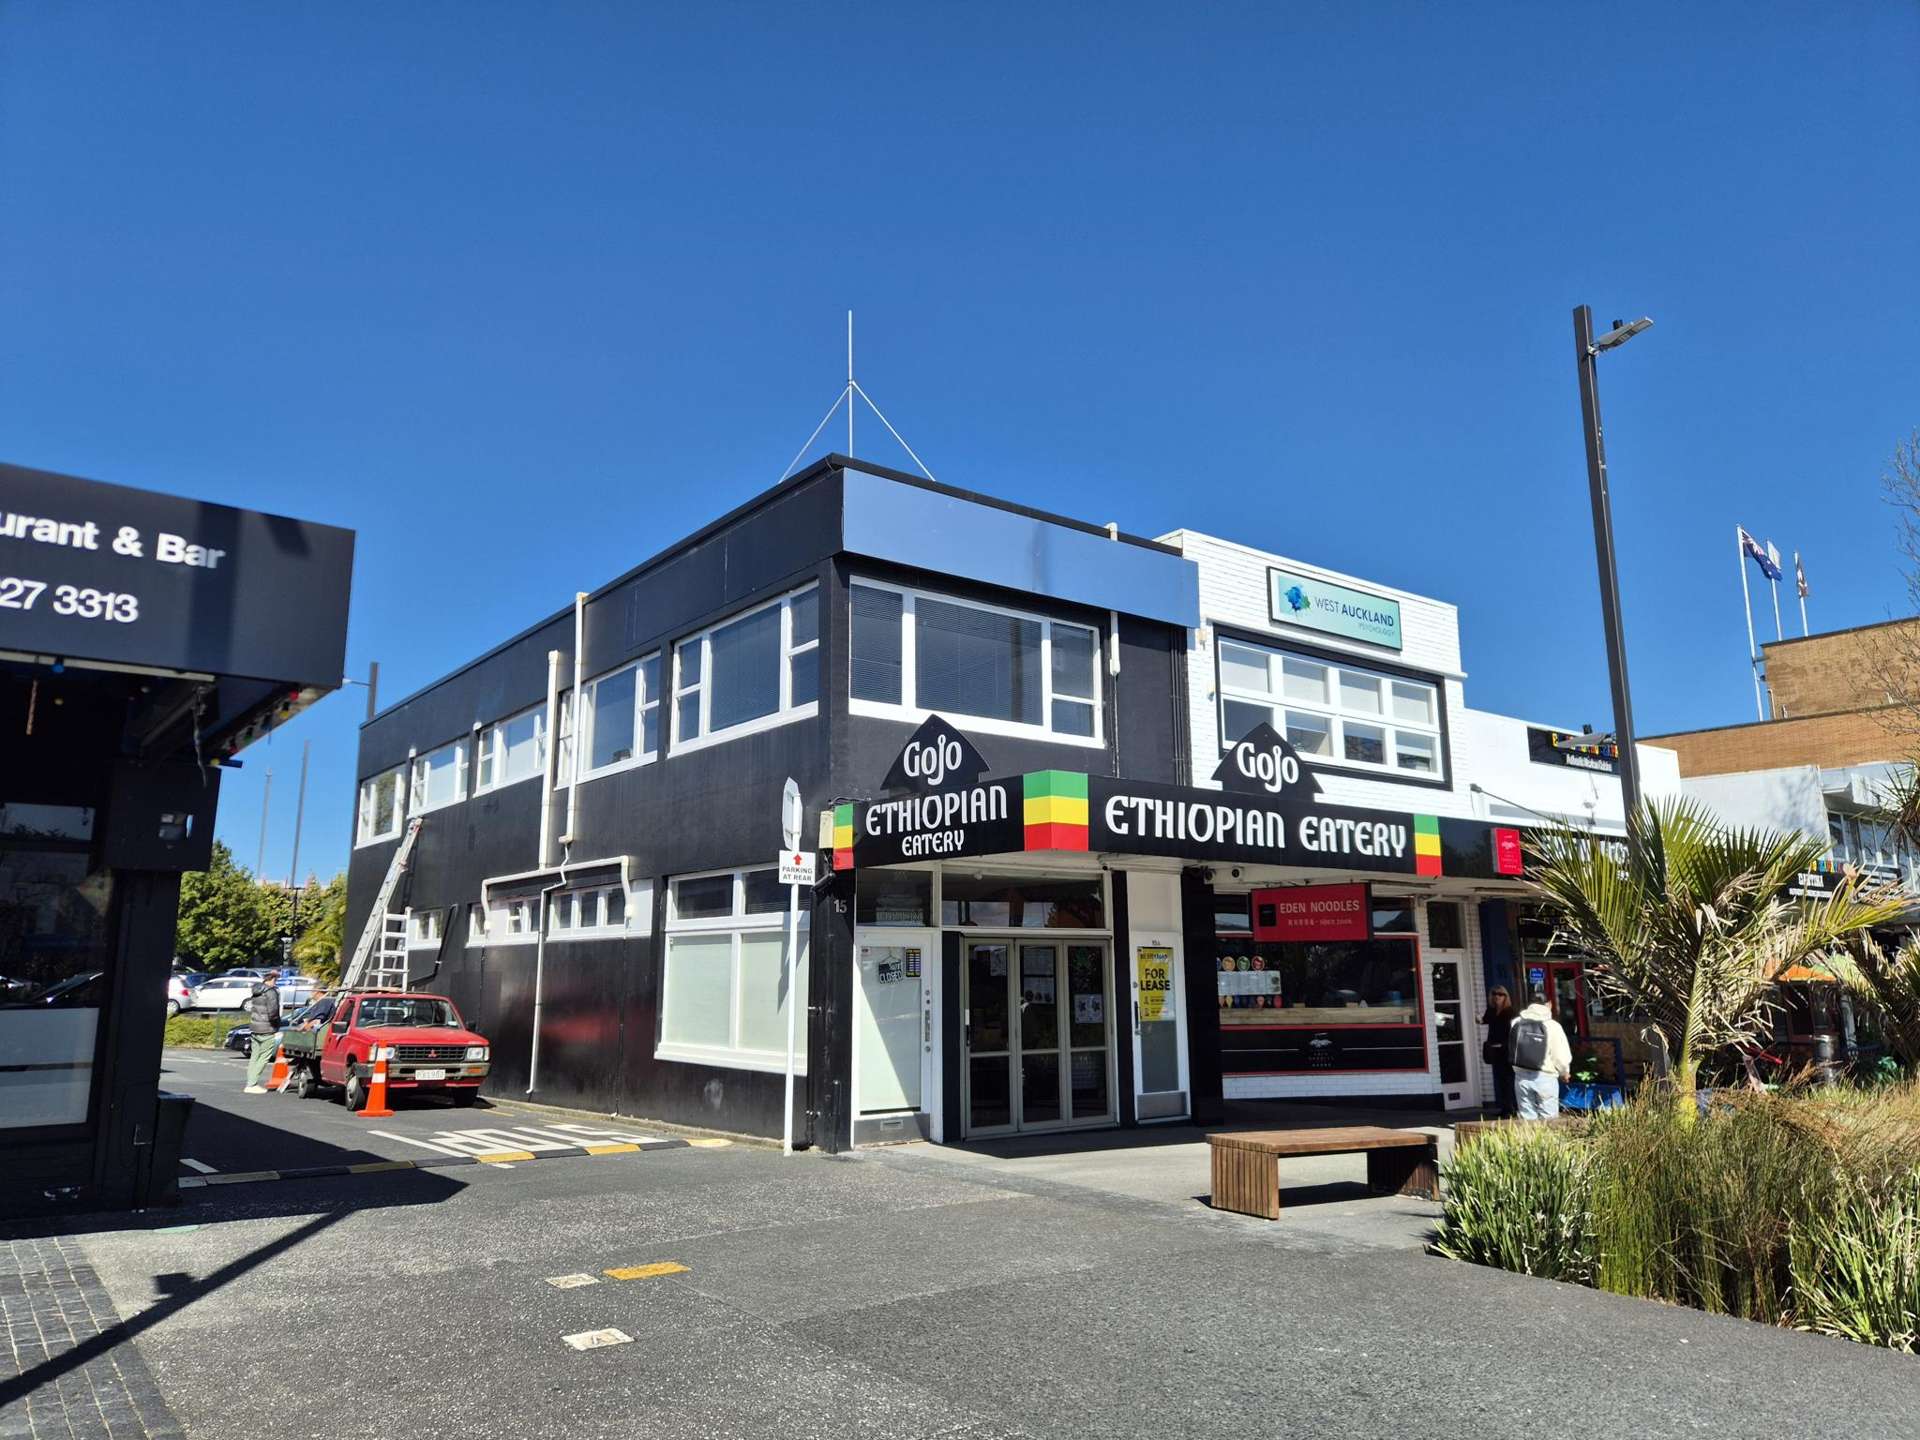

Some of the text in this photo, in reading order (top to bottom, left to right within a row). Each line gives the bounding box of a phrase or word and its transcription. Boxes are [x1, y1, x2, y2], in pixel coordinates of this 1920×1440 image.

[112, 526, 144, 557] &
[156, 532, 226, 568] Bar
[0, 577, 139, 623] 27 3313
[1315, 597, 1393, 626] WEST AUCKLAND
[866, 785, 1008, 836] ETHIOPIAN
[1105, 795, 1406, 858] ETHIOPIAN EATERY
[901, 829, 965, 856] EATERY
[782, 866, 813, 874] PARKING
[833, 899, 848, 914] 15
[1280, 900, 1360, 914] EDEN NOODLES
[1140, 980, 1171, 991] LEASE
[1144, 968, 1165, 979] FOR
